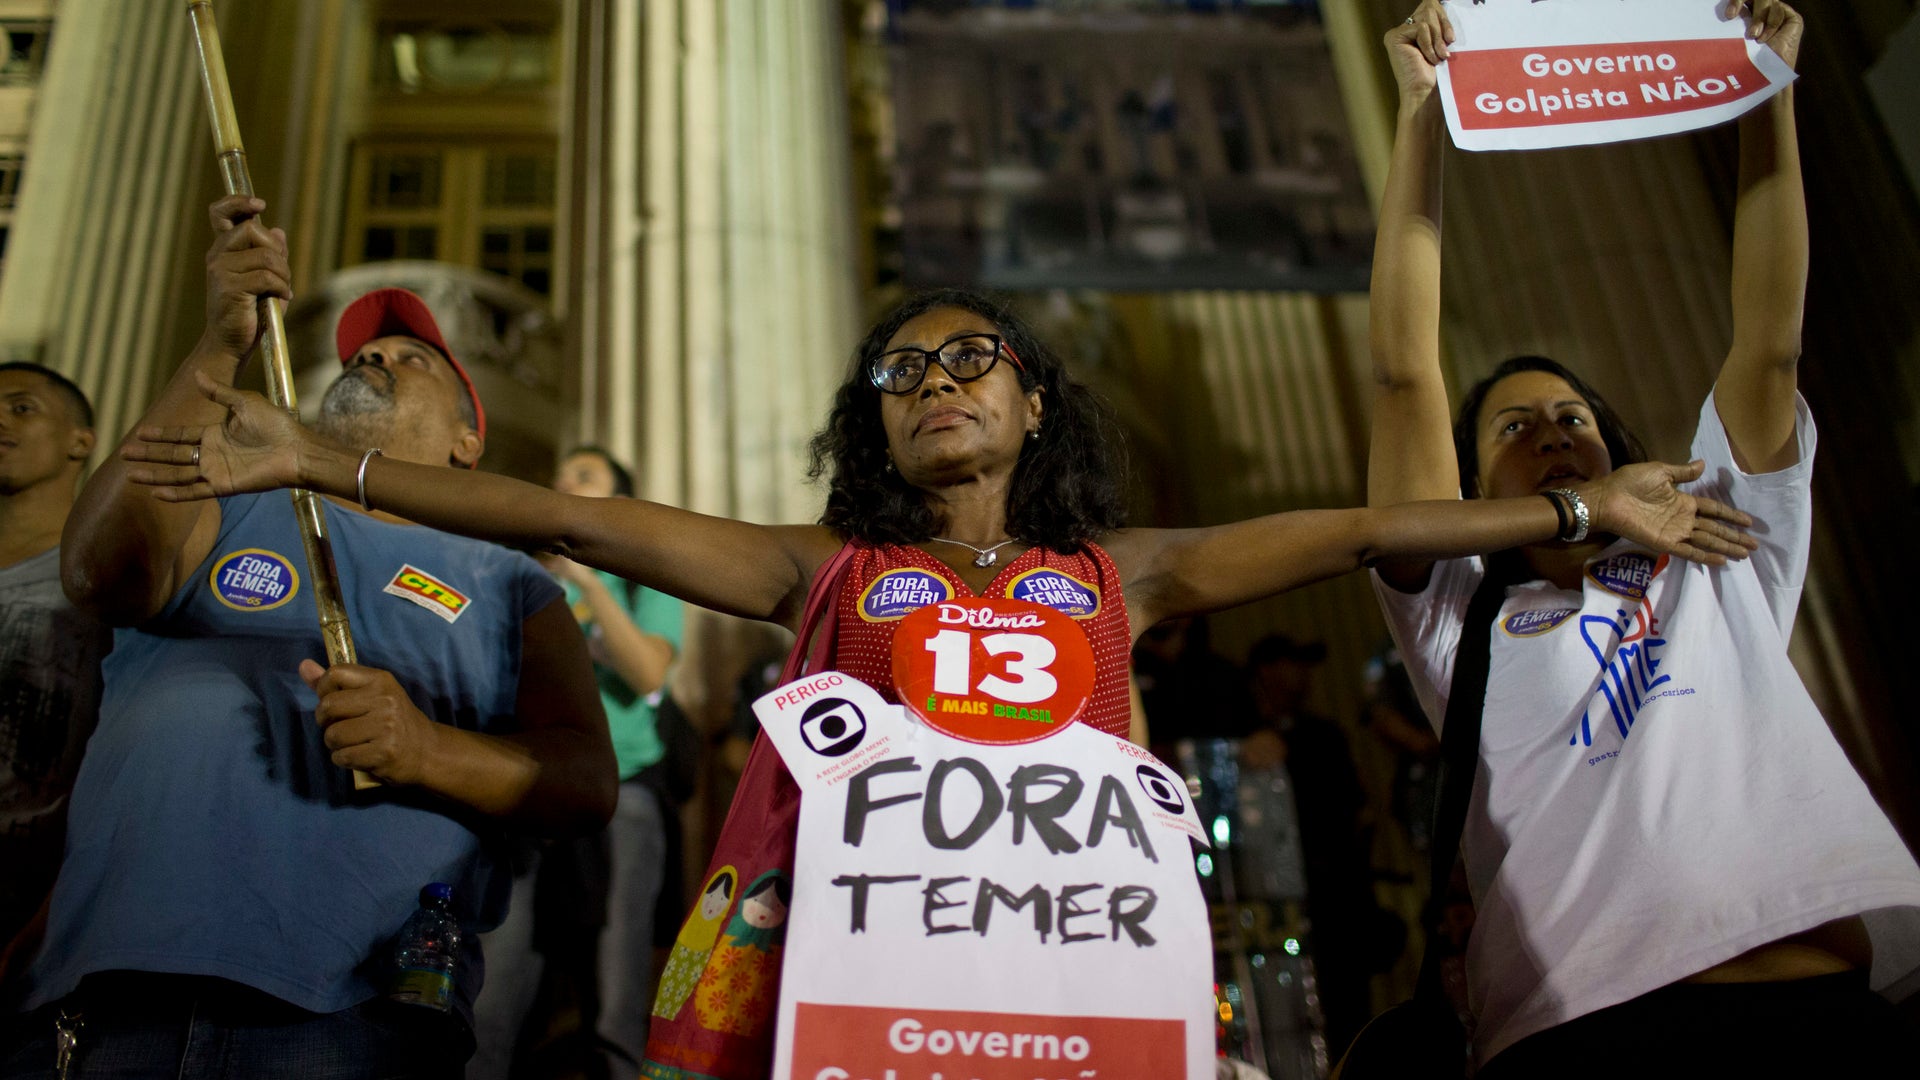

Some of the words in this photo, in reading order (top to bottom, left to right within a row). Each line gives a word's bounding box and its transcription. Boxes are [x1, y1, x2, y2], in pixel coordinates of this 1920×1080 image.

[1522, 53, 1676, 77] Governo
[1475, 89, 1629, 116] Golpista
[1640, 75, 1742, 103] NÃO!
[238, 556, 281, 581] FORA
[1607, 556, 1651, 573] FORA
[223, 568, 285, 599] TEMER!
[401, 573, 462, 608] CTB
[881, 577, 930, 592] FORA
[1024, 576, 1075, 595] FORA
[246, 597, 262, 606] 65
[872, 590, 939, 609] TEMER!
[1021, 590, 1093, 606] TEMER!
[1069, 606, 1086, 614] 65
[938, 604, 1046, 628] Dilma
[925, 629, 1058, 703] 13
[774, 675, 843, 711] PERIGO
[927, 693, 936, 711] É
[942, 699, 988, 716] MAIS
[993, 703, 1054, 723] BRASIL
[841, 750, 865, 766] GLOBO
[865, 736, 890, 752] MENTE
[870, 747, 890, 761] POVO
[842, 756, 1159, 863] FORA
[831, 873, 1158, 948] TEMER
[889, 1018, 1090, 1061] Governo
